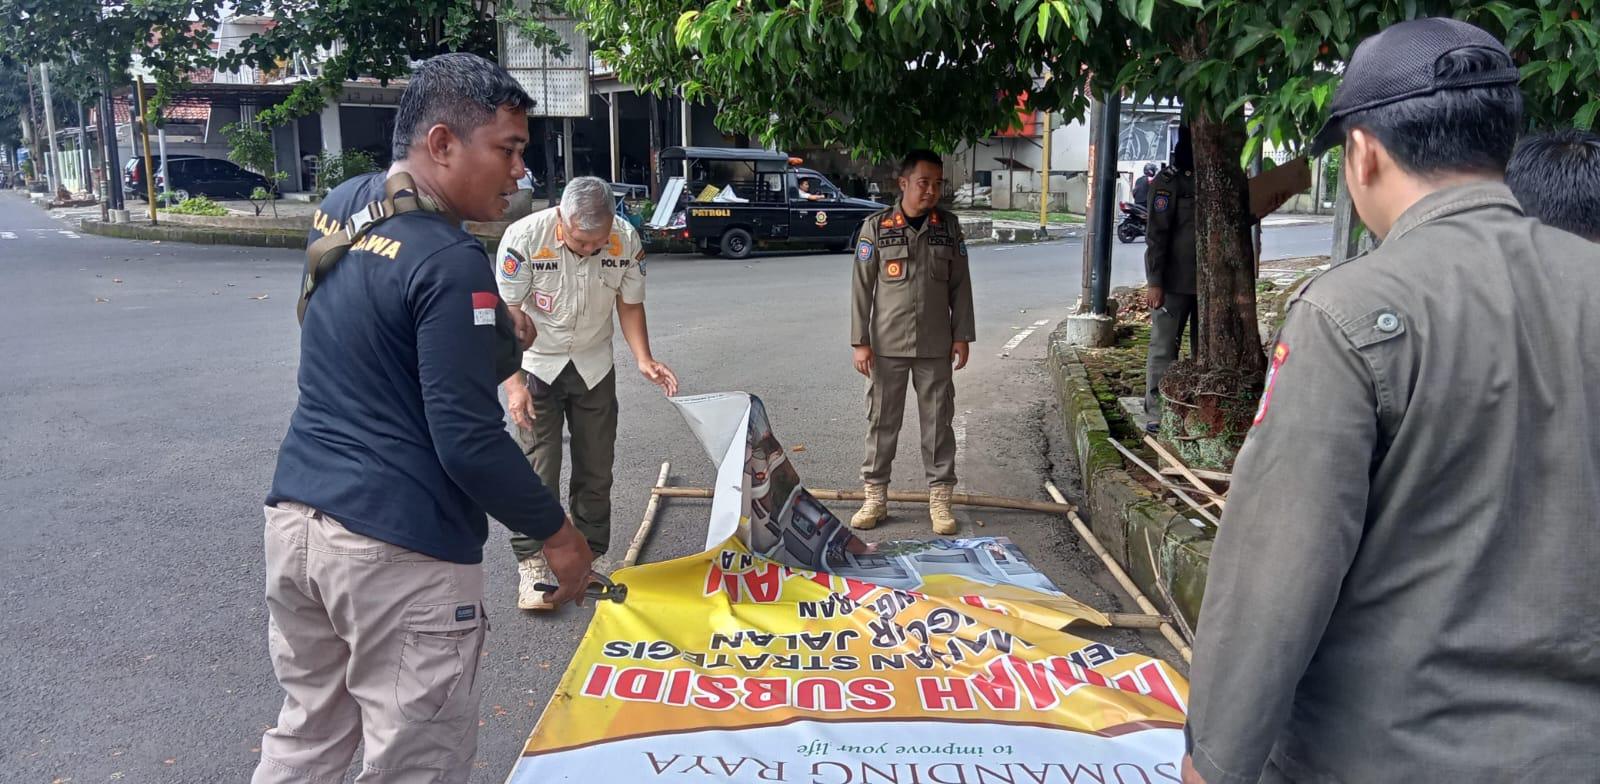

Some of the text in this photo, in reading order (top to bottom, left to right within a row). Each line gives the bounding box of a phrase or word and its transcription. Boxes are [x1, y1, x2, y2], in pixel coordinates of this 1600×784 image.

[692, 209, 731, 217] PATROLI
[601, 259, 616, 268] POL
[711, 630, 859, 650] JALAN
[603, 640, 860, 671] STRATEGIS
[580, 665, 895, 712] SUBSIDI
[797, 738, 1013, 757] to improve your life
[644, 751, 1182, 784] SUMANDING RAYA
